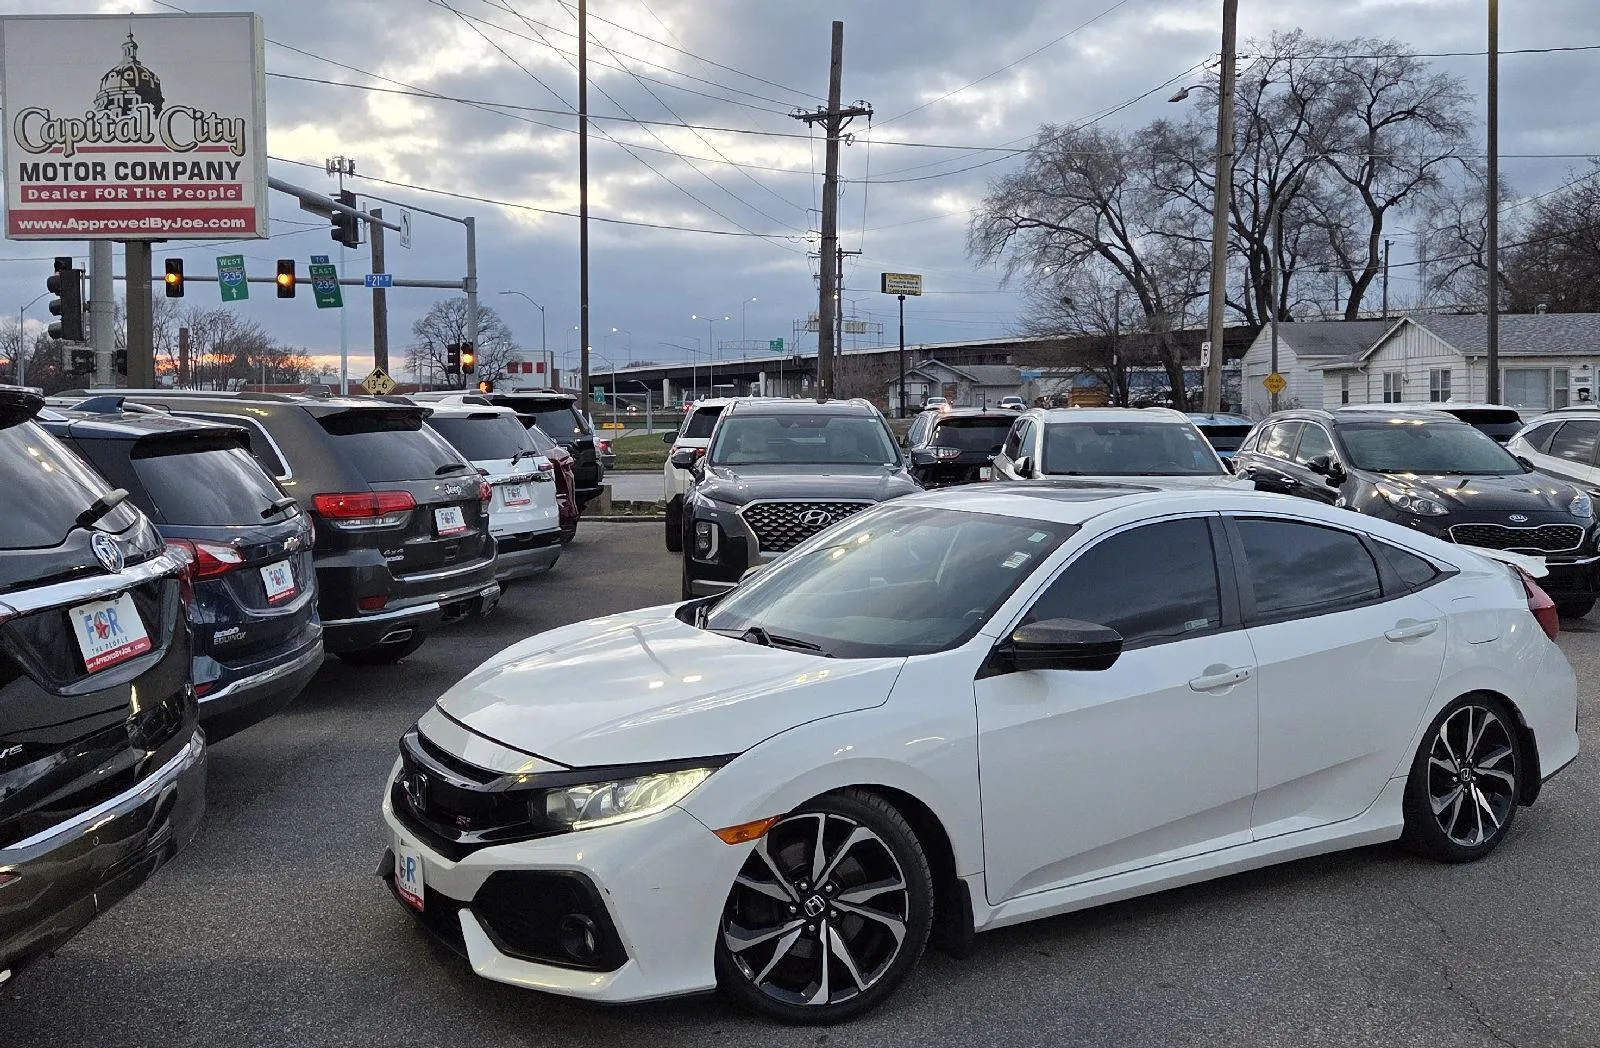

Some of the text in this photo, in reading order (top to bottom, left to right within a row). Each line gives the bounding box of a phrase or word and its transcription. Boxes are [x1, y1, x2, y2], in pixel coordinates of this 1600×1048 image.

[13, 105, 246, 158] Capital City
[19, 160, 242, 182] MOTOR COMPANY
[28, 186, 237, 201] Dealer FOR The People
[18, 217, 246, 230] www.ApprovedByJoe.com
[223, 271, 243, 282] 235
[316, 280, 336, 289] 235
[445, 484, 462, 496] Jeep
[83, 608, 125, 645] FOR
[213, 631, 247, 645] EQUINOX
